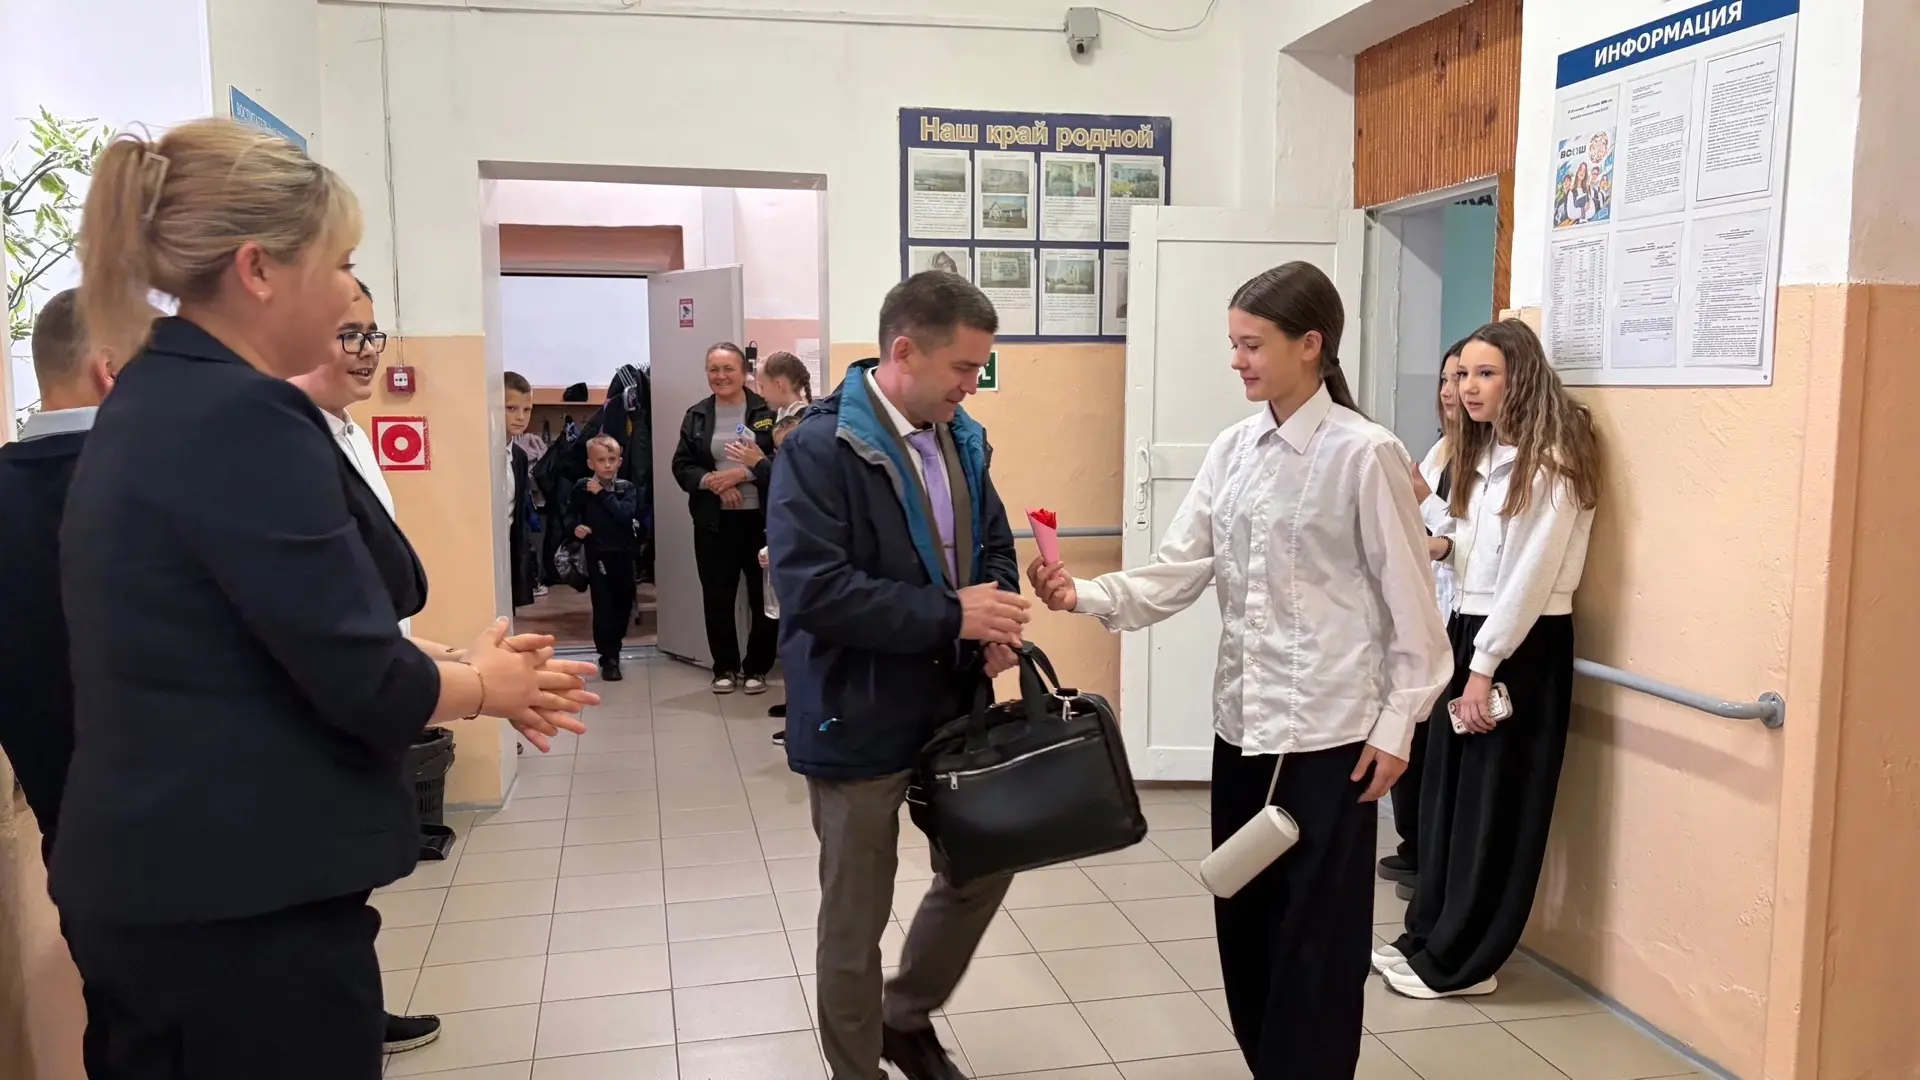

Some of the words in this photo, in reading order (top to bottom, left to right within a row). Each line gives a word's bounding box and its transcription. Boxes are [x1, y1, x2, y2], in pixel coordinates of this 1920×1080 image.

[1594, 0, 1743, 67] ИНФОРМАЦИЯ
[920, 116, 978, 143] Наш
[986, 120, 1048, 149] край
[1056, 124, 1154, 150] родной
